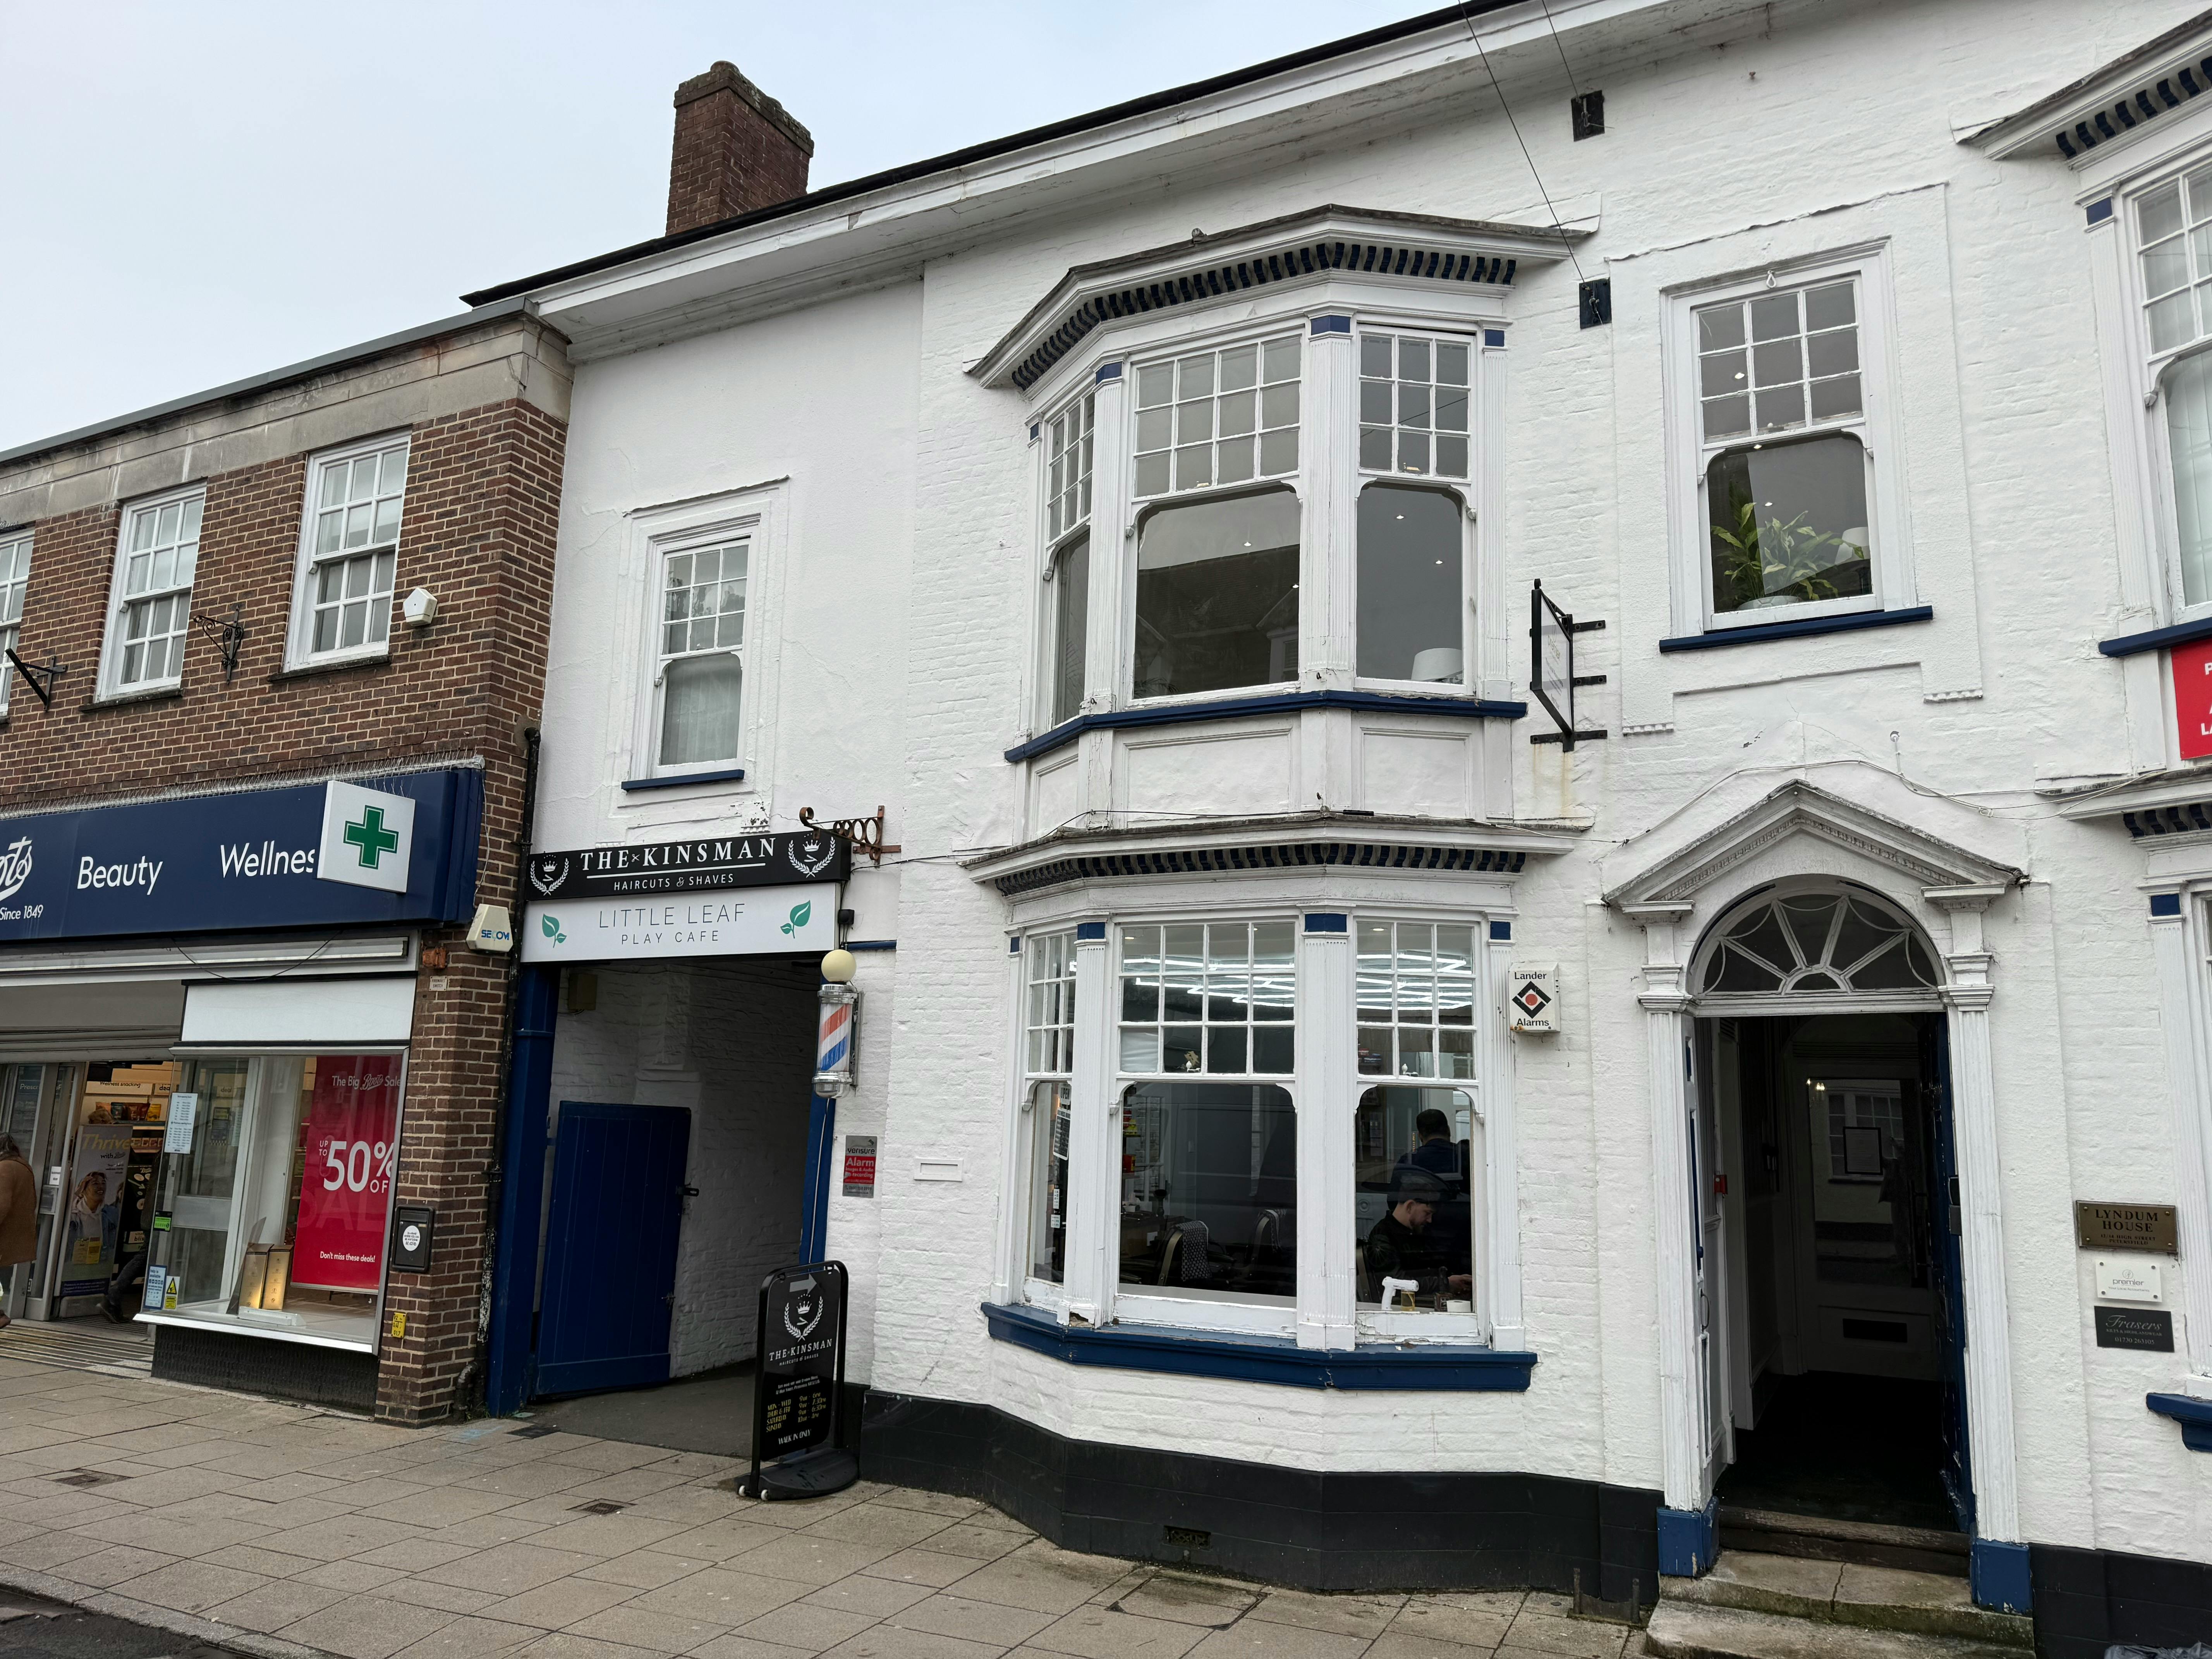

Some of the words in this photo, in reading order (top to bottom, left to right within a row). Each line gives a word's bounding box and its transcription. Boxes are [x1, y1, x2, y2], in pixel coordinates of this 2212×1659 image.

[220, 840, 315, 878] Wellnes
[580, 849, 629, 871] THE
[643, 837, 776, 866] KINSMAN
[77, 856, 163, 895] Beauty
[614, 878, 670, 891] HAIRCUTS
[676, 876, 684, 887] &
[689, 873, 734, 886] SHAVES
[0, 907, 21, 921] Since
[24, 904, 43, 919] 1849
[599, 907, 675, 928] LITTLE
[688, 903, 745, 924] LEAF
[481, 929, 510, 941] SECOM
[621, 933, 663, 945] PLAY
[675, 930, 718, 943] CAFE
[1514, 971, 1547, 980] Lander
[1516, 1018, 1549, 1026] Alarms
[332, 1076, 346, 1086] The
[348, 1075, 360, 1090] Big
[360, 1073, 383, 1091] Boots
[385, 1075, 400, 1086] Sale
[82, 1133, 131, 1150] Thrive
[323, 1140, 394, 1192] 50%
[846, 1157, 874, 1167] Alarm
[370, 1180, 389, 1193] OF
[2095, 1209, 2158, 1221] LYNDUM
[2103, 1221, 2153, 1232] HOUSE
[320, 1251, 333, 1259] Don't
[2106, 1315, 2162, 1331] Frasers
[769, 1349, 787, 1361] THE
[790, 1338, 832, 1356] KINSMAN
[779, 1358, 798, 1366] HAIRCUTS
